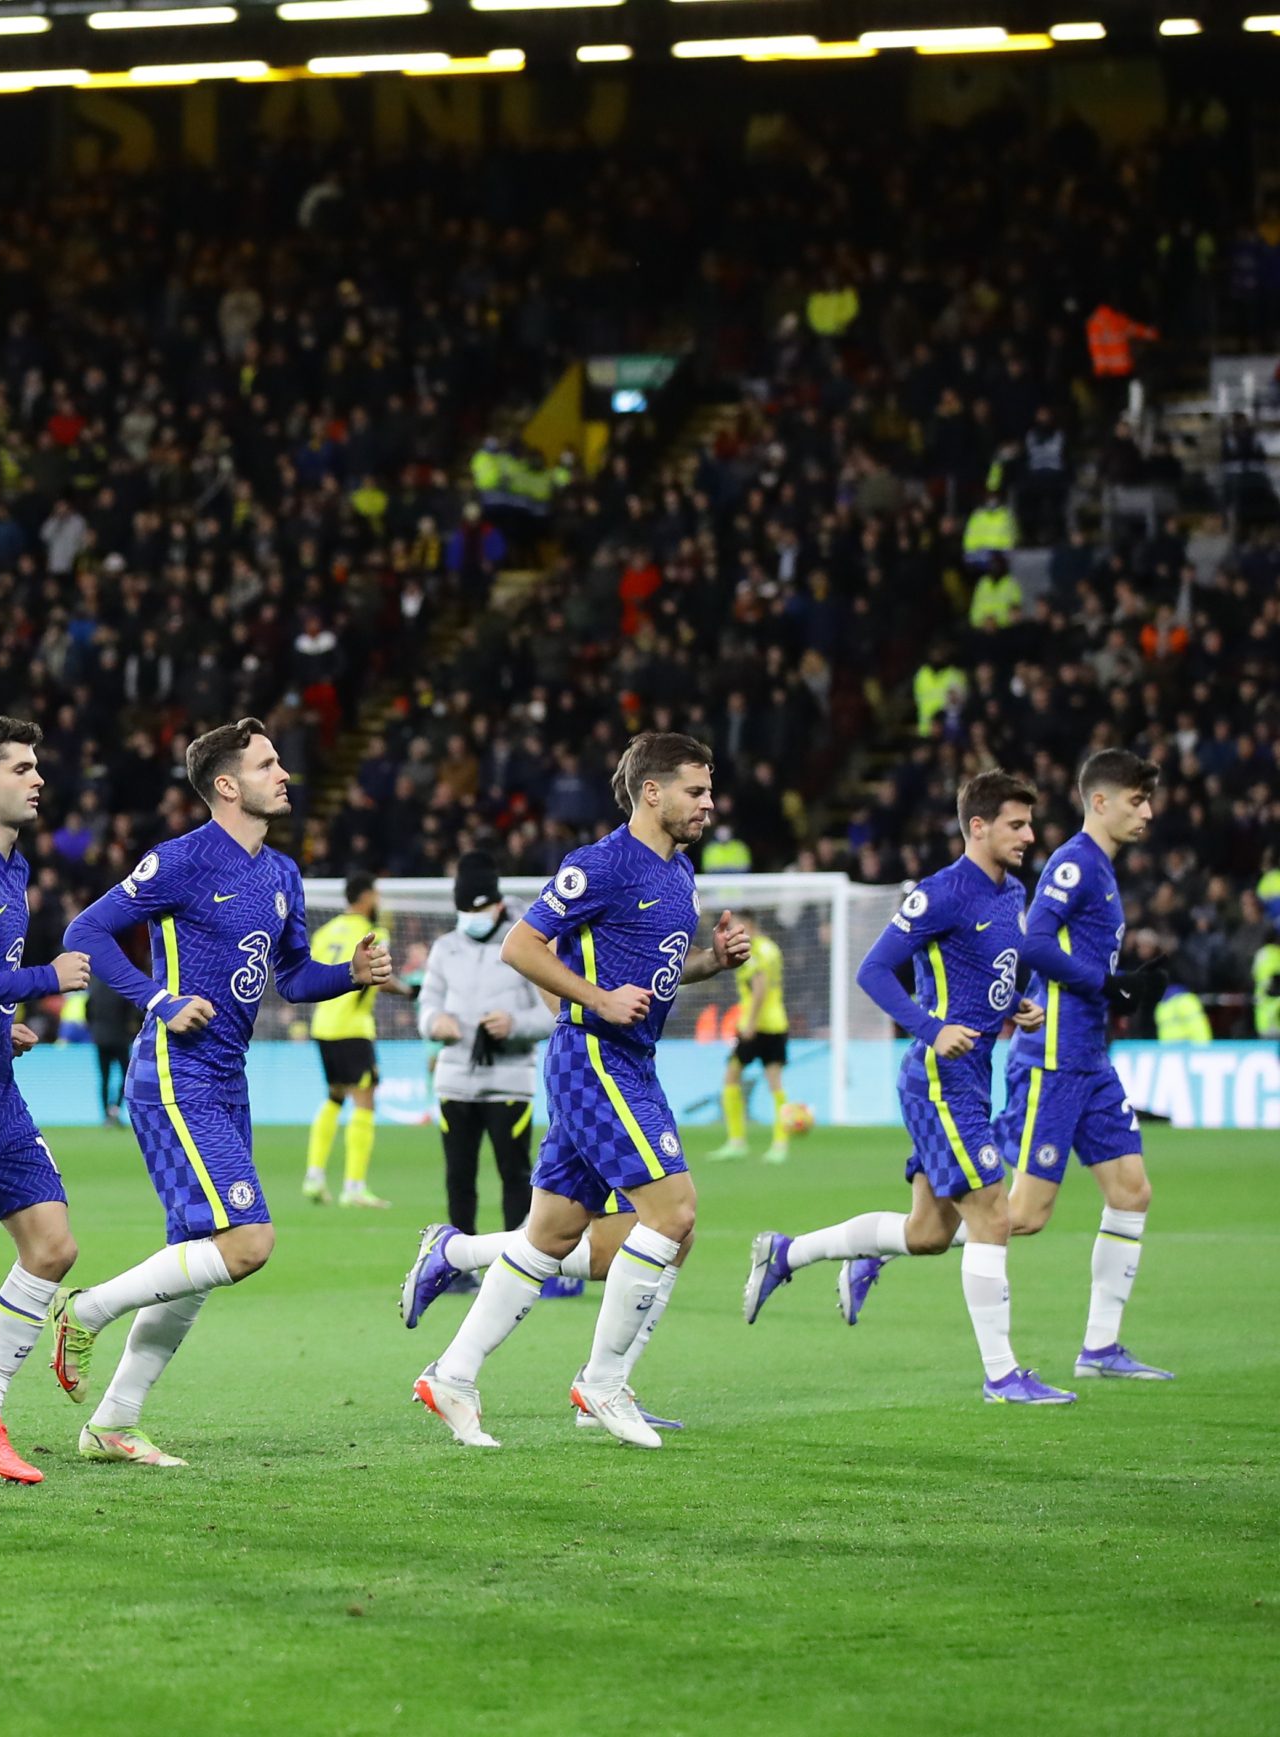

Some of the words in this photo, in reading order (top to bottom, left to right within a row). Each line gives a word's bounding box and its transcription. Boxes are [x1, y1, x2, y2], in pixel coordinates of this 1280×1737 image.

[230, 930, 271, 1004] 3
[651, 930, 689, 1002] 3
[1114, 1051, 1280, 1129] ATC
